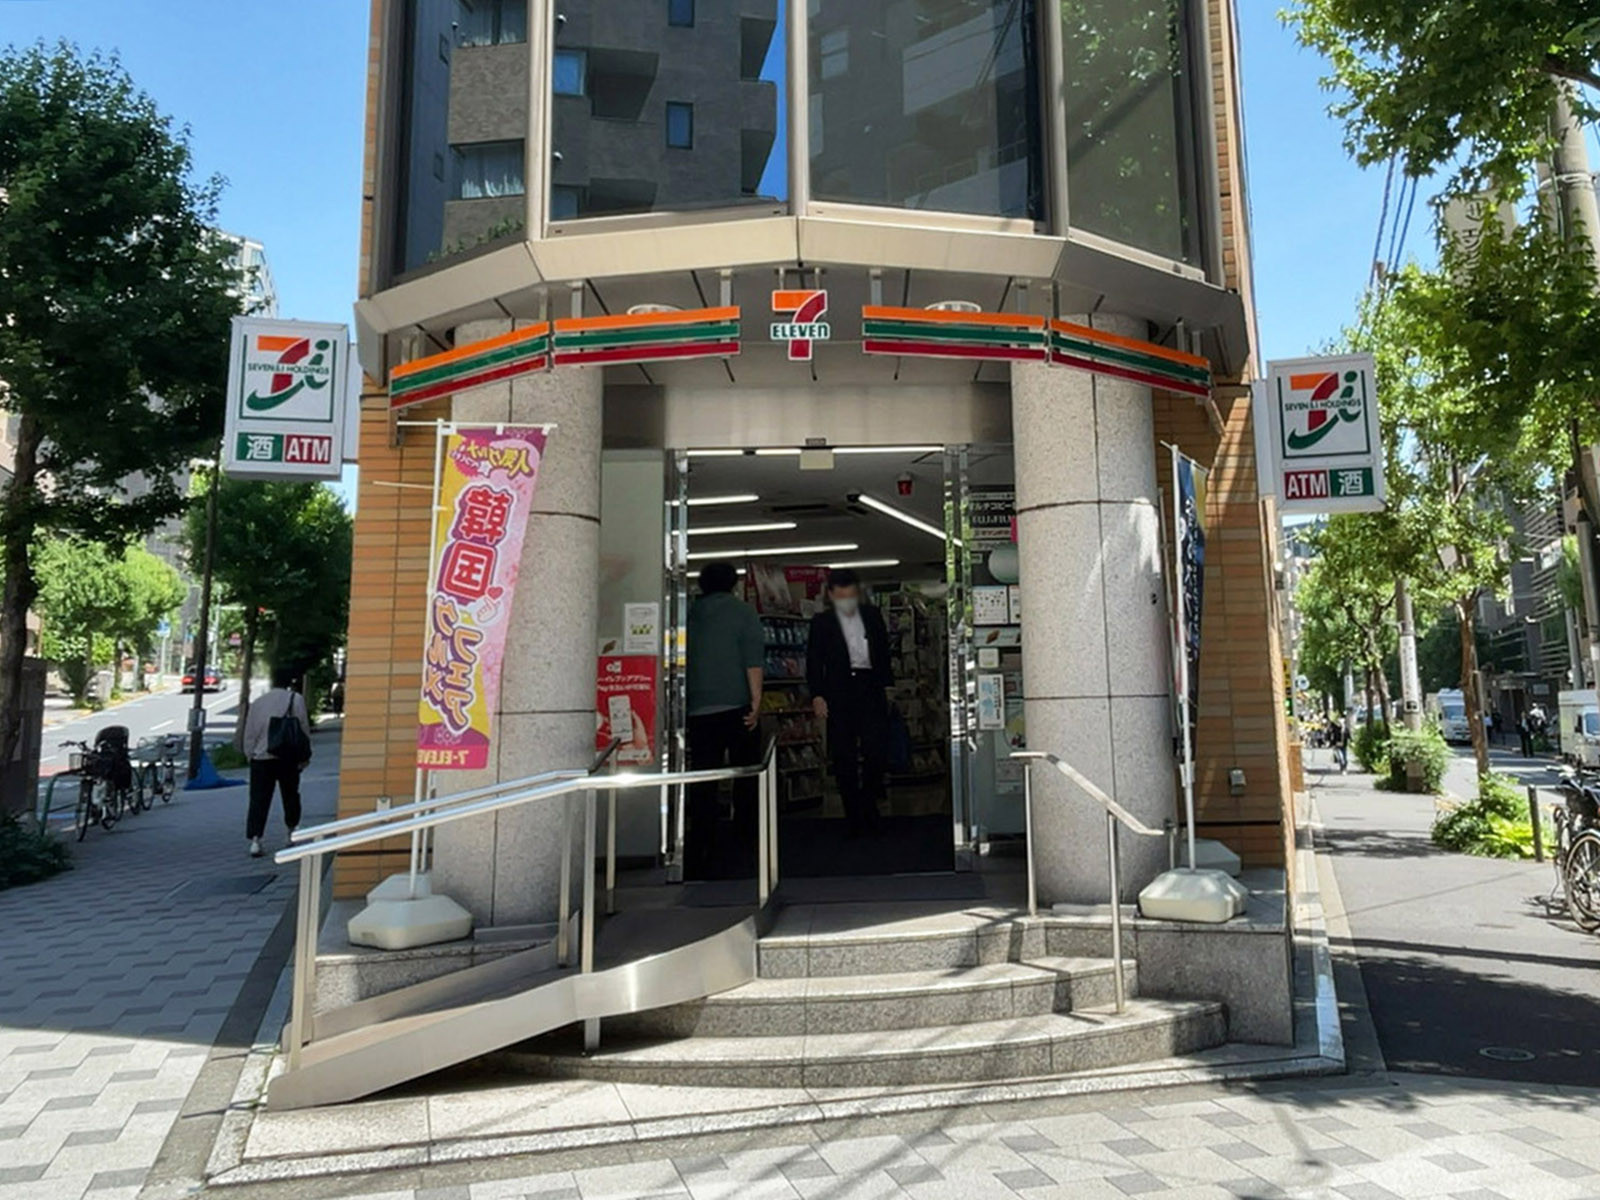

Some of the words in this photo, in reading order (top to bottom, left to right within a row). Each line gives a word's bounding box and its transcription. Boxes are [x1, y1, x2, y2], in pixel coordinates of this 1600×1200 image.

[286, 364, 330, 375] HOLDINGS
[1320, 398, 1362, 409] HOLDINGS
[246, 435, 275, 460] 酒
[286, 438, 330, 461] ATM
[1287, 473, 1327, 497] ATM
[1338, 470, 1363, 495] 酒
